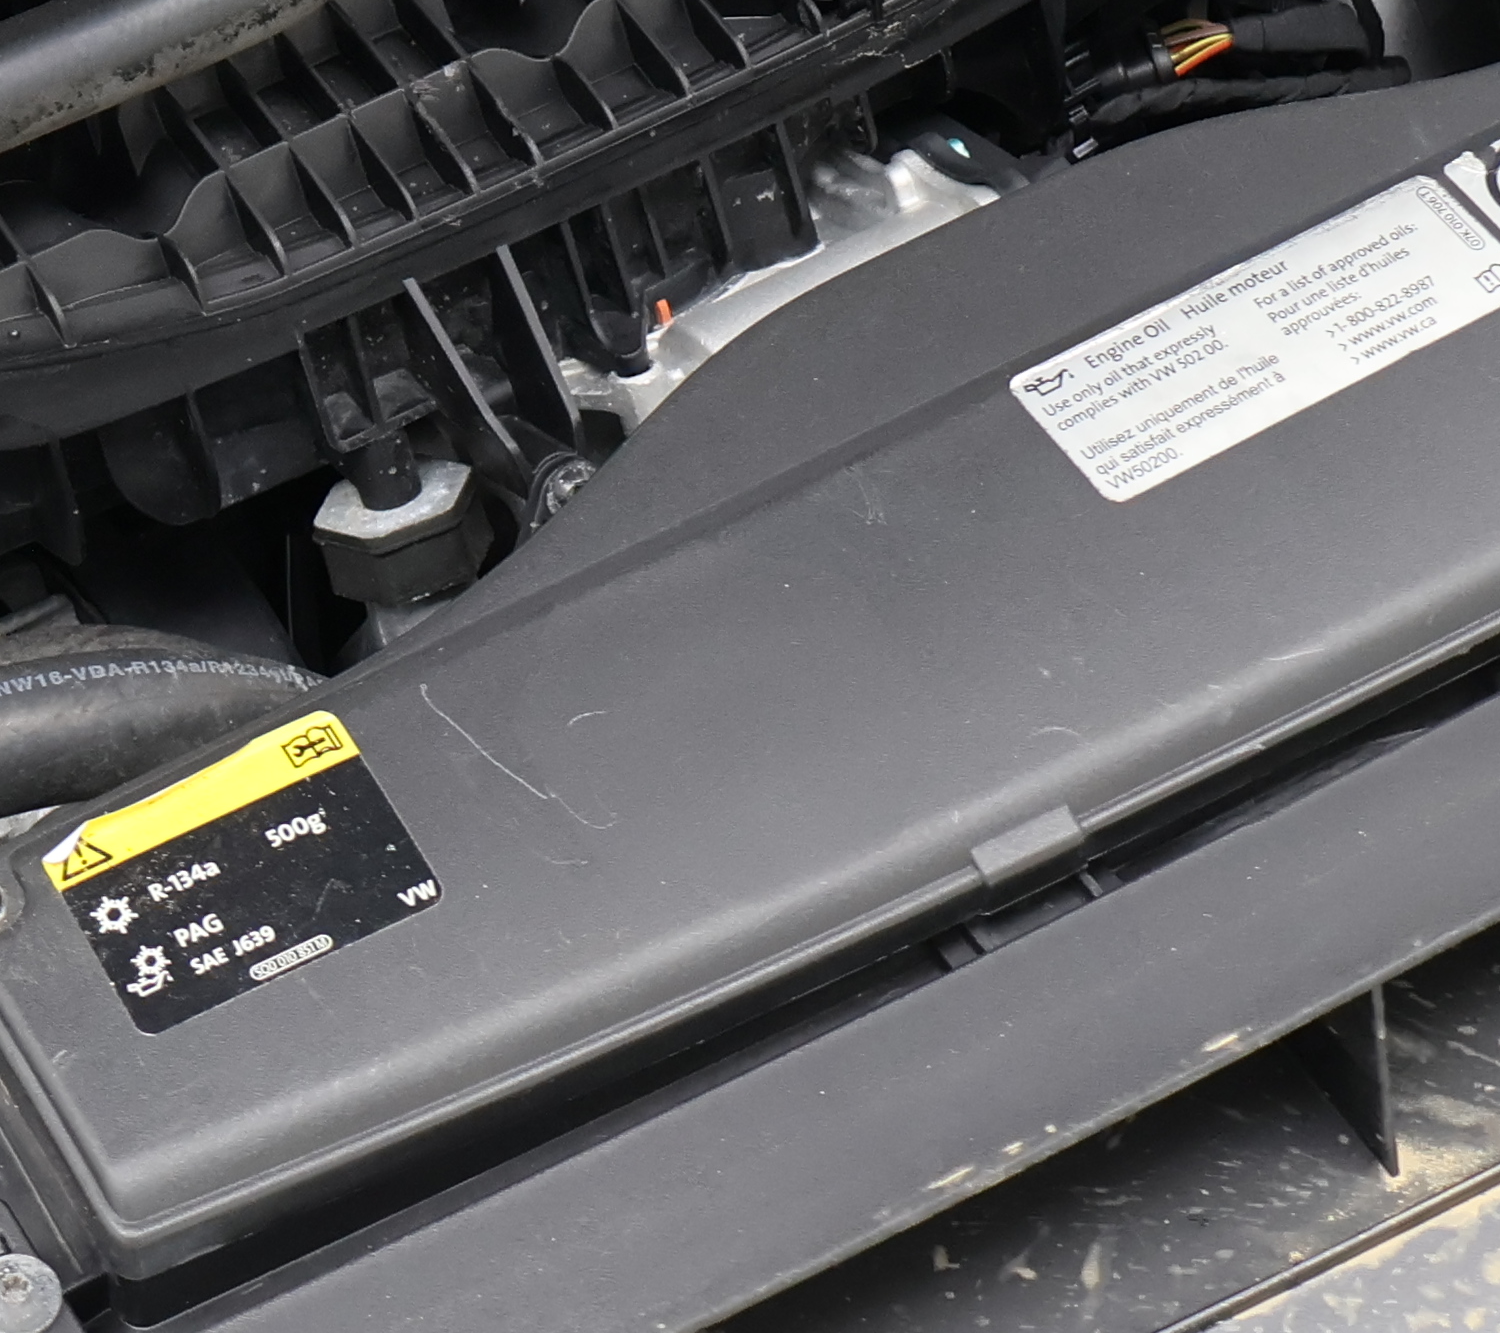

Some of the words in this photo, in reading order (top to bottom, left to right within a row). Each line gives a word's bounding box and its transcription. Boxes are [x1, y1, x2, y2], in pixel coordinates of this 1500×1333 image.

[1251, 291, 1278, 309] For
[1277, 287, 1290, 298] a
[1284, 274, 1313, 292] list
[1310, 263, 1328, 280] of
[1326, 233, 1390, 272] approved
[1388, 223, 1418, 241] oils:
[1265, 300, 1301, 324] Pour
[1300, 287, 1330, 307] une
[1324, 272, 1359, 293] liste
[1357, 246, 1411, 278] d'huiles
[1082, 333, 1145, 369] Engine
[1141, 317, 1171, 339] Oil
[1178, 291, 1229, 320] Huile
[1226, 259, 1288, 297] moteur
[1279, 291, 1362, 336] approuvées:
[1346, 295, 1438, 346] www.vw.com
[1359, 315, 1437, 359] www.vw.ca
[1040, 397, 1073, 417] Use
[1071, 381, 1104, 403] only
[1102, 368, 1123, 387] oil
[1119, 355, 1155, 377] that
[1152, 323, 1216, 361] expressly
[1055, 394, 1119, 432] complies
[1116, 376, 1152, 399] with
[1147, 361, 1177, 382] VW
[1174, 348, 1206, 370] 502
[1201, 338, 1229, 356] 00.
[1078, 427, 1137, 460] Utilisez
[1134, 383, 1220, 433] uniquement
[1217, 375, 1239, 391] de
[1234, 353, 1280, 380] l'huile
[1094, 454, 1120, 475] qui
[1118, 427, 1177, 463] satisfait
[1174, 376, 1274, 434] expressément
[1271, 370, 1286, 383] à
[1104, 443, 1184, 491] VW50200.
[263, 810, 327, 848] 500g
[146, 860, 221, 902] R-134a
[395, 878, 437, 907] VW
[171, 912, 224, 948] PAG
[188, 945, 230, 975] SAE
[231, 924, 276, 956] J639
